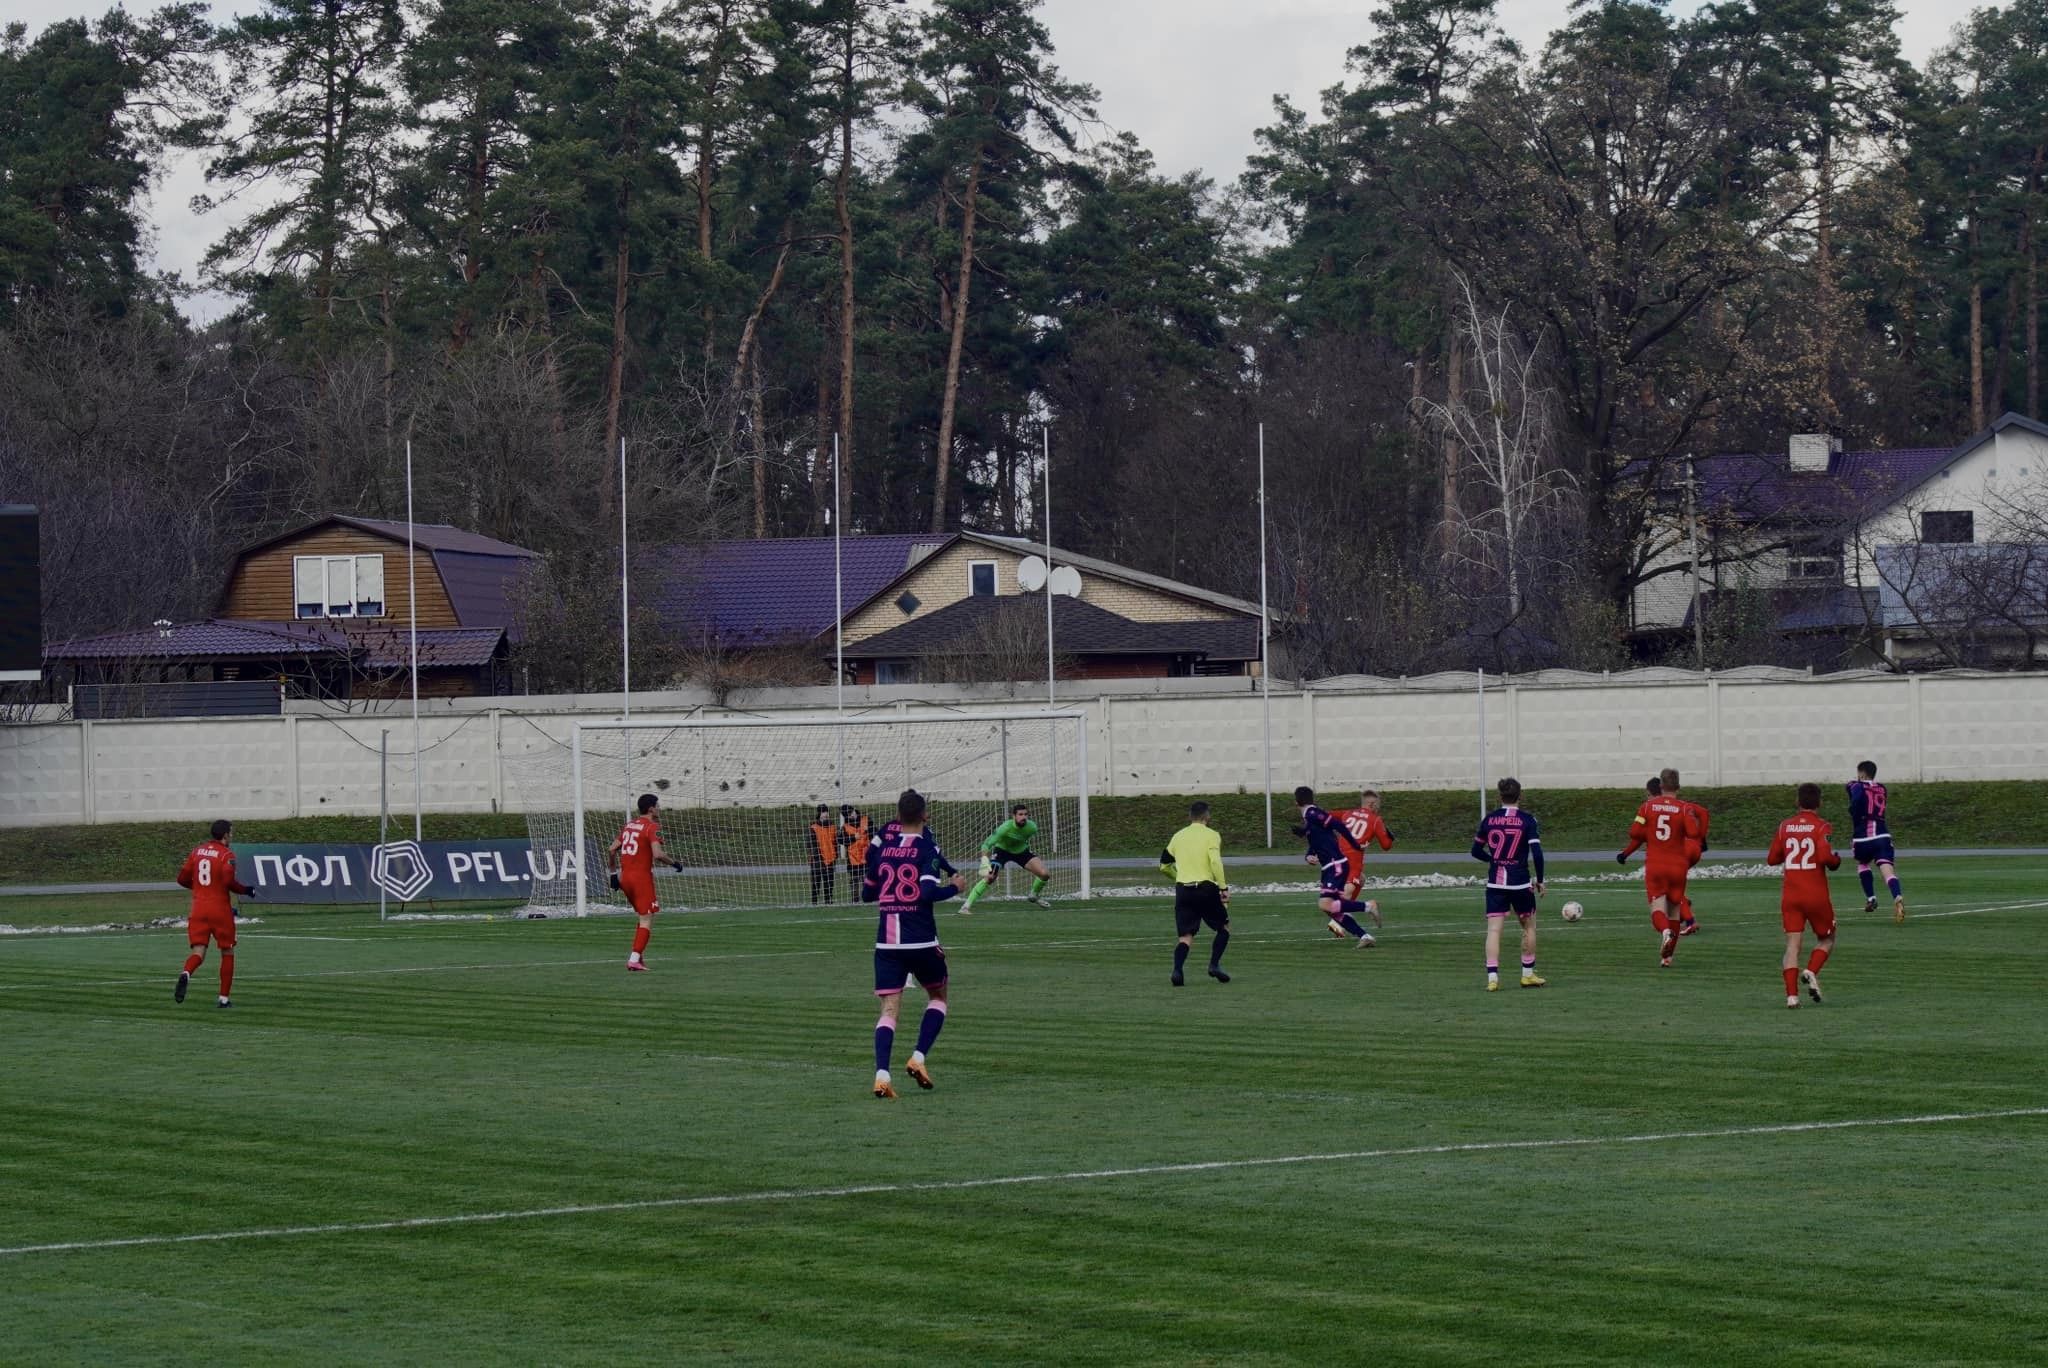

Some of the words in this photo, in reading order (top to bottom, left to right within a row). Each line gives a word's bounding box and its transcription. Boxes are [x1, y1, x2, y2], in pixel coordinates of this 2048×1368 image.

[1865, 790, 1886, 816] 19
[1345, 816, 1368, 840] 20
[1655, 814, 1671, 841] 5
[621, 830, 640, 856] 25
[1487, 829, 1522, 859] 97
[1785, 837, 1817, 870] 22
[198, 858, 211, 886] 8
[253, 854, 352, 887] ПФЛ
[446, 849, 588, 884] PFL.UA
[878, 862, 921, 902] 28
